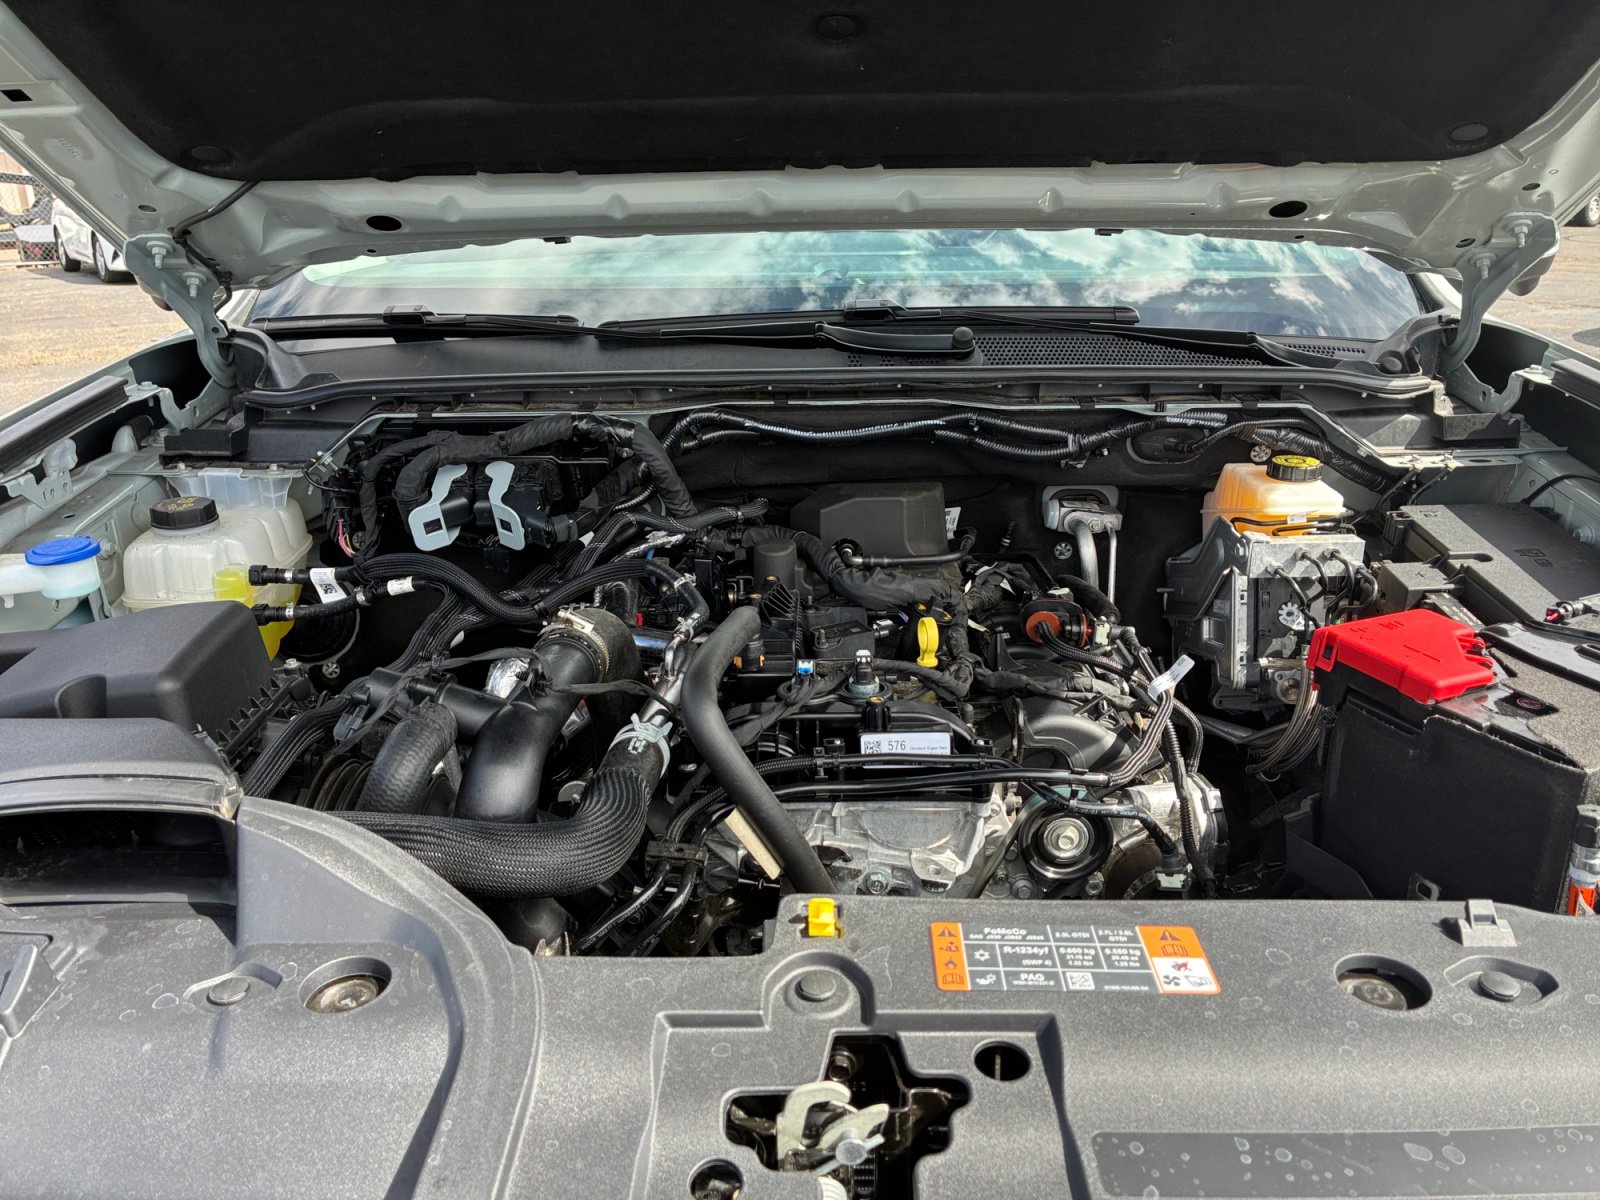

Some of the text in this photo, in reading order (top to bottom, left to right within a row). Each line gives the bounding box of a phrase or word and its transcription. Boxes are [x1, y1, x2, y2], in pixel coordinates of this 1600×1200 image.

[888, 740, 906, 751] 576
[984, 927, 1027, 935] FoMoCo
[1003, 946, 1049, 956] R-1234yf
[1083, 947, 1096, 955] kg
[1129, 948, 1141, 956] kg
[1020, 973, 1045, 981] PAG
